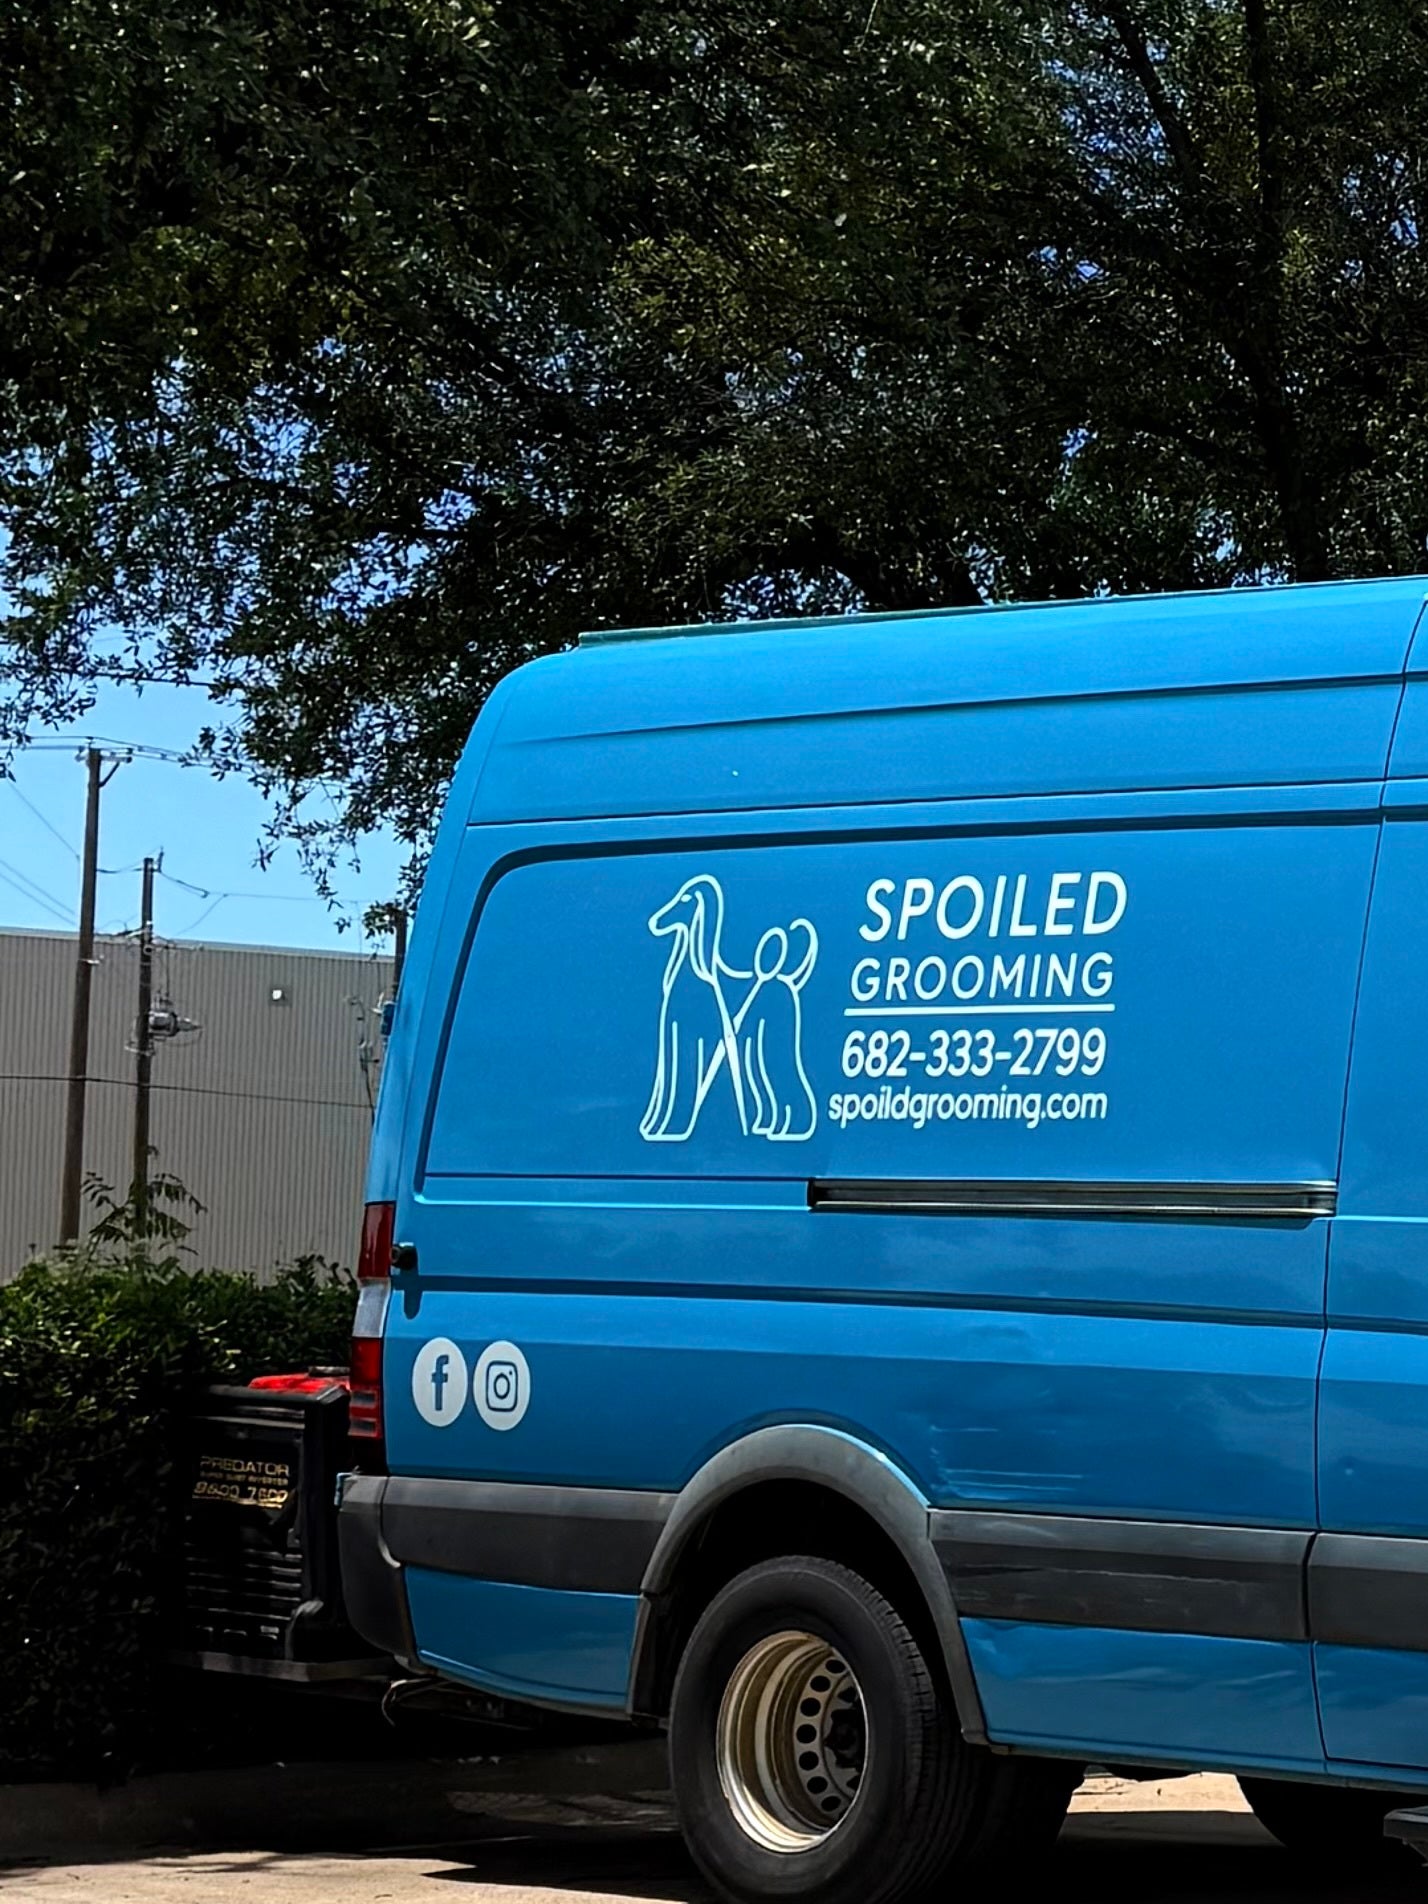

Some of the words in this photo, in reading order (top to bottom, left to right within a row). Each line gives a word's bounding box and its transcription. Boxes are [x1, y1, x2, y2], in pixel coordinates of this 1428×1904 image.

[860, 872, 1127, 941] SPOILED
[851, 953, 1113, 1001] GROOMING
[842, 1028, 1106, 1077] 682-333-2799
[828, 1084, 1107, 1128] spoildgrooming.com
[200, 1455, 290, 1477] PREDATOR
